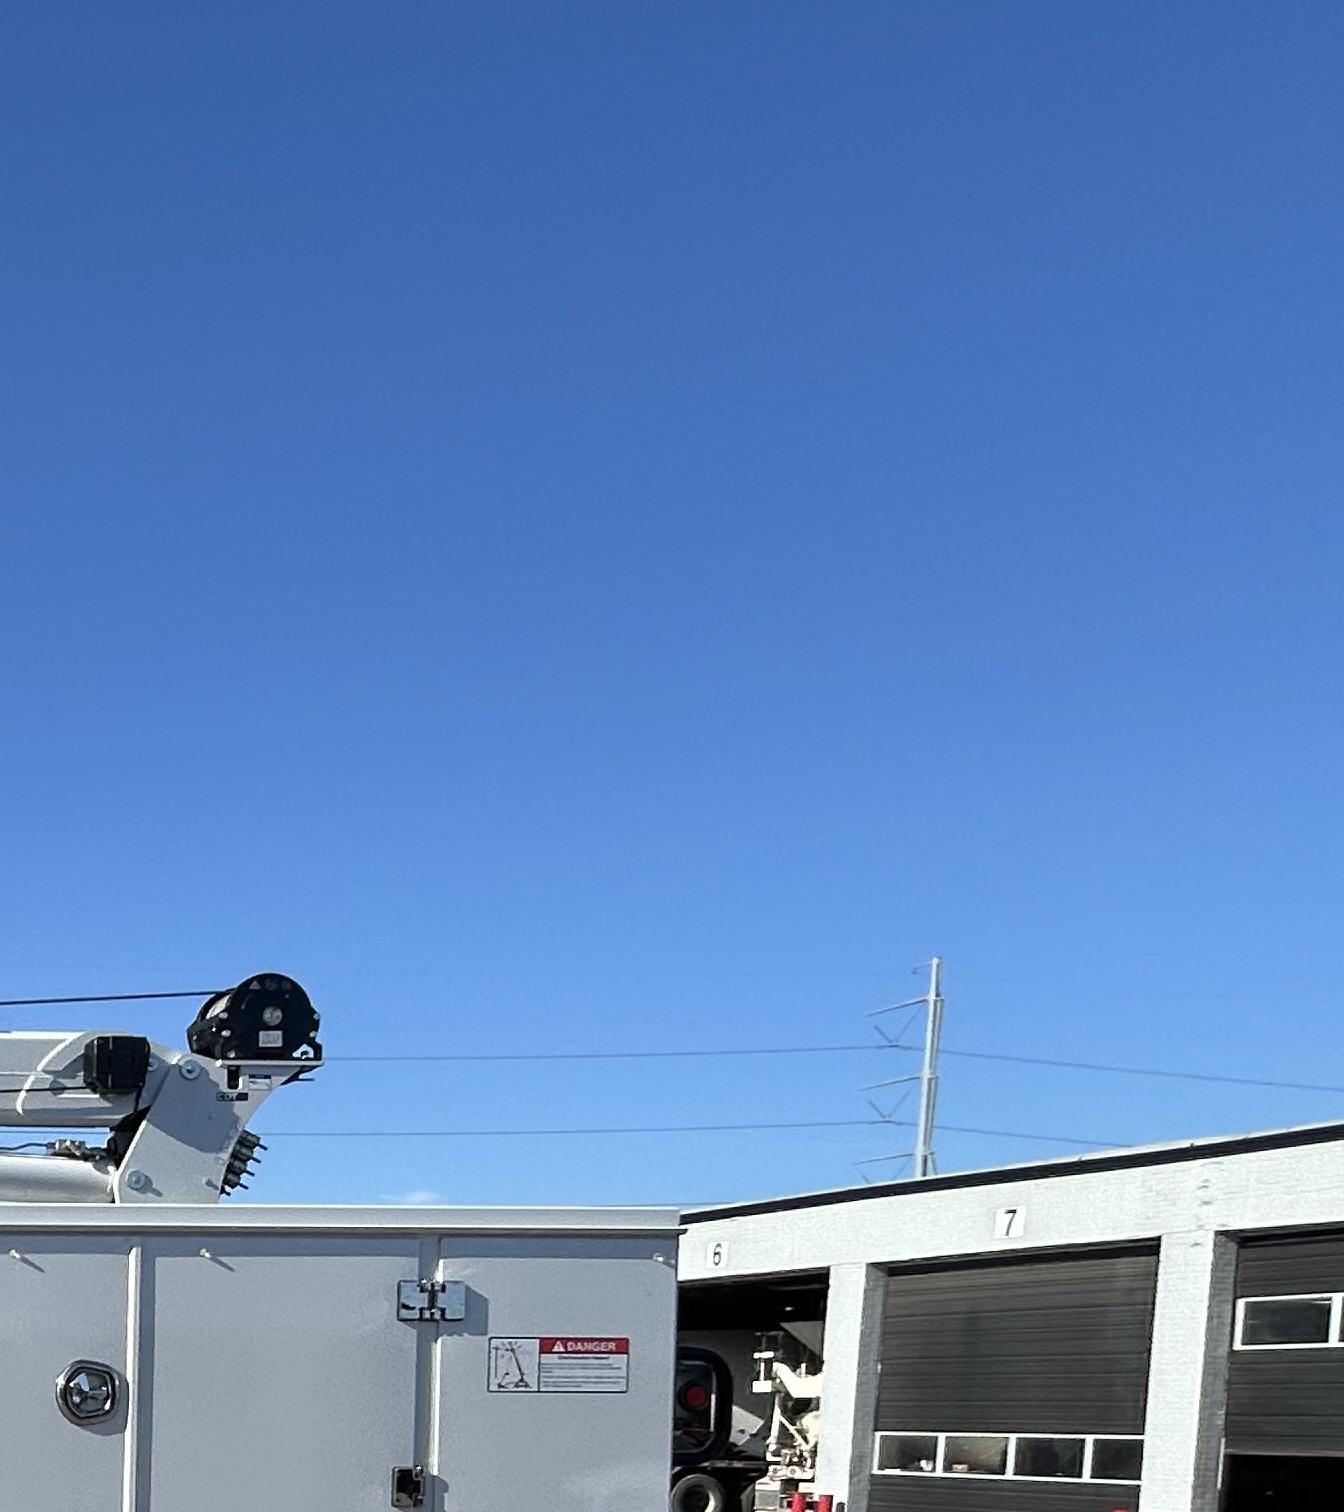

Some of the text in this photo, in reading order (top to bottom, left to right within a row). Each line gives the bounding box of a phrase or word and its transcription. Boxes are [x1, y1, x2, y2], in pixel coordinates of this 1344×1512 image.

[1003, 1209, 1018, 1237] 7
[712, 1242, 722, 1267] 6
[567, 1341, 617, 1352] DANGER
